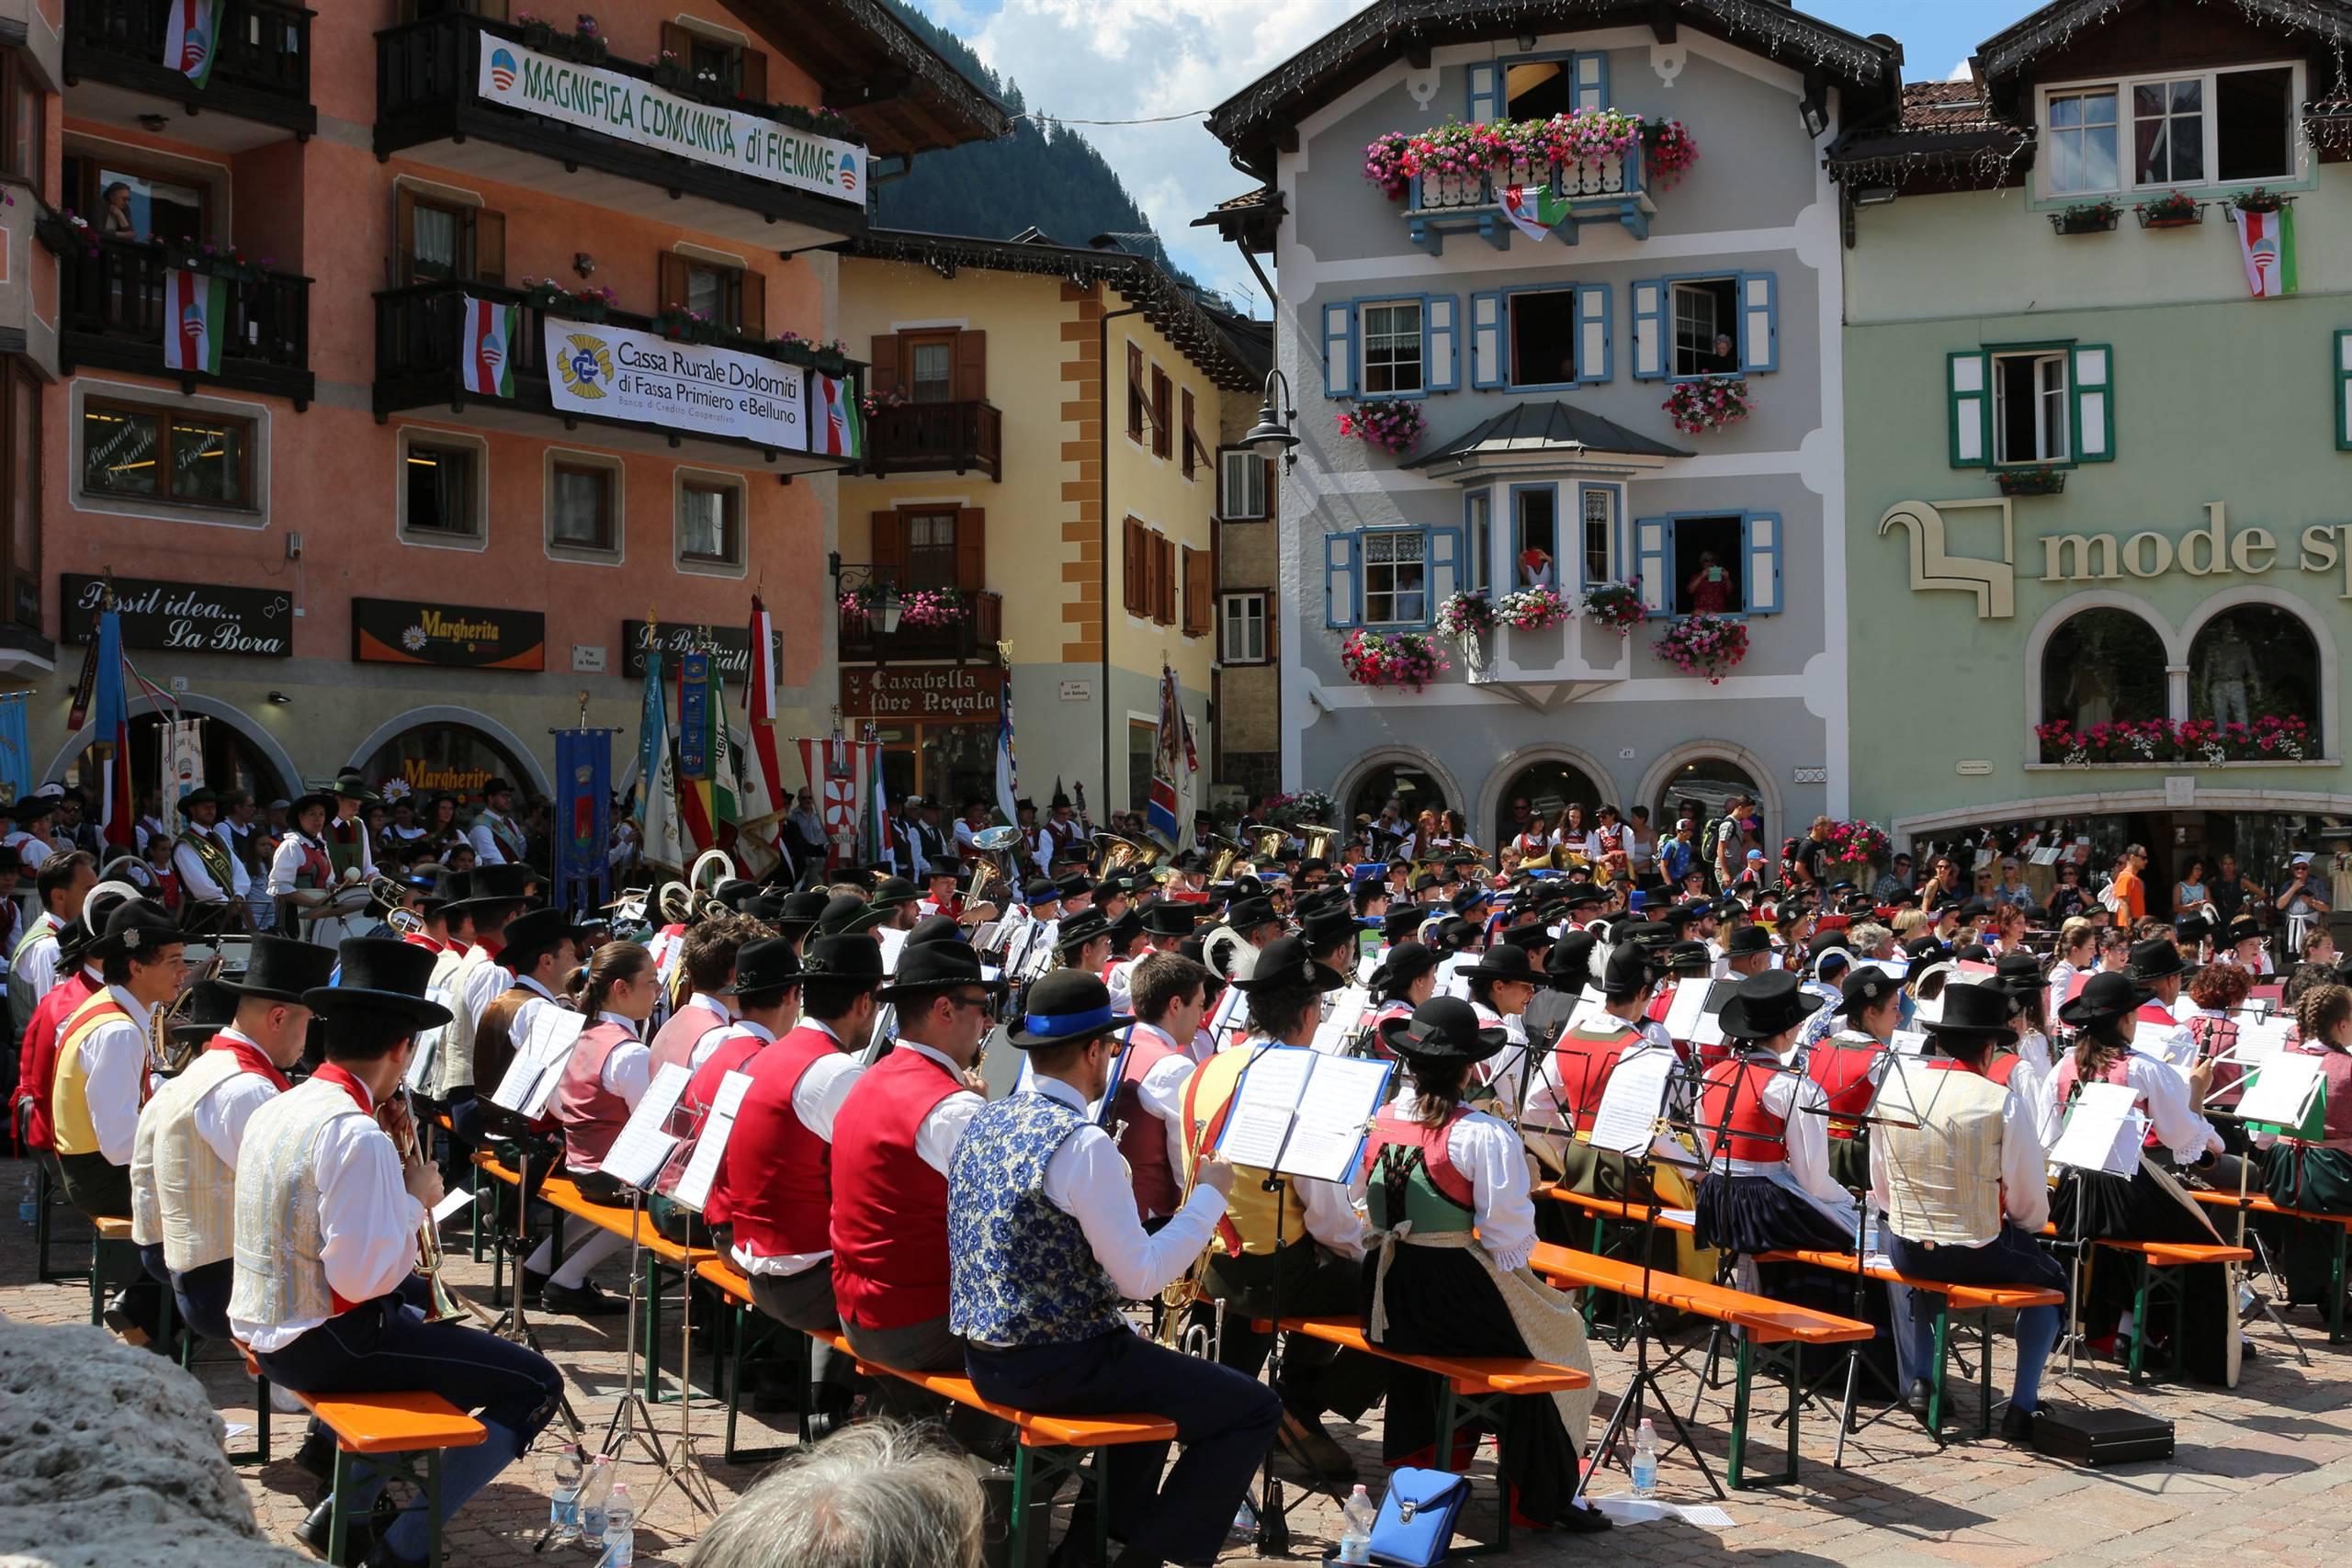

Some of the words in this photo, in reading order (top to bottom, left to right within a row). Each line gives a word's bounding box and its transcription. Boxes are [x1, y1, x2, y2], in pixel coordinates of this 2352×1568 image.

[524, 57, 635, 129] MAGNIFICA
[640, 94, 736, 159] COMUNITÀ
[745, 128, 762, 164] di
[767, 132, 836, 186] FIEMME
[618, 342, 667, 372] Cassa
[673, 351, 725, 382] Rurale
[729, 362, 797, 399] Dolomiti
[618, 374, 630, 393] di
[636, 377, 673, 400] Fassa
[676, 383, 734, 411] Primiero
[618, 396, 643, 409] Banca
[656, 401, 686, 416] Credito
[688, 407, 736, 423] Cooperativo
[2040, 501, 2277, 581] mode
[78, 581, 162, 615] Tssil
[163, 619, 209, 648] La
[210, 623, 286, 652] Bora
[421, 609, 499, 643] Margherita
[869, 669, 976, 690] Casabella
[869, 692, 911, 711] Idee
[922, 691, 995, 716] Regalo
